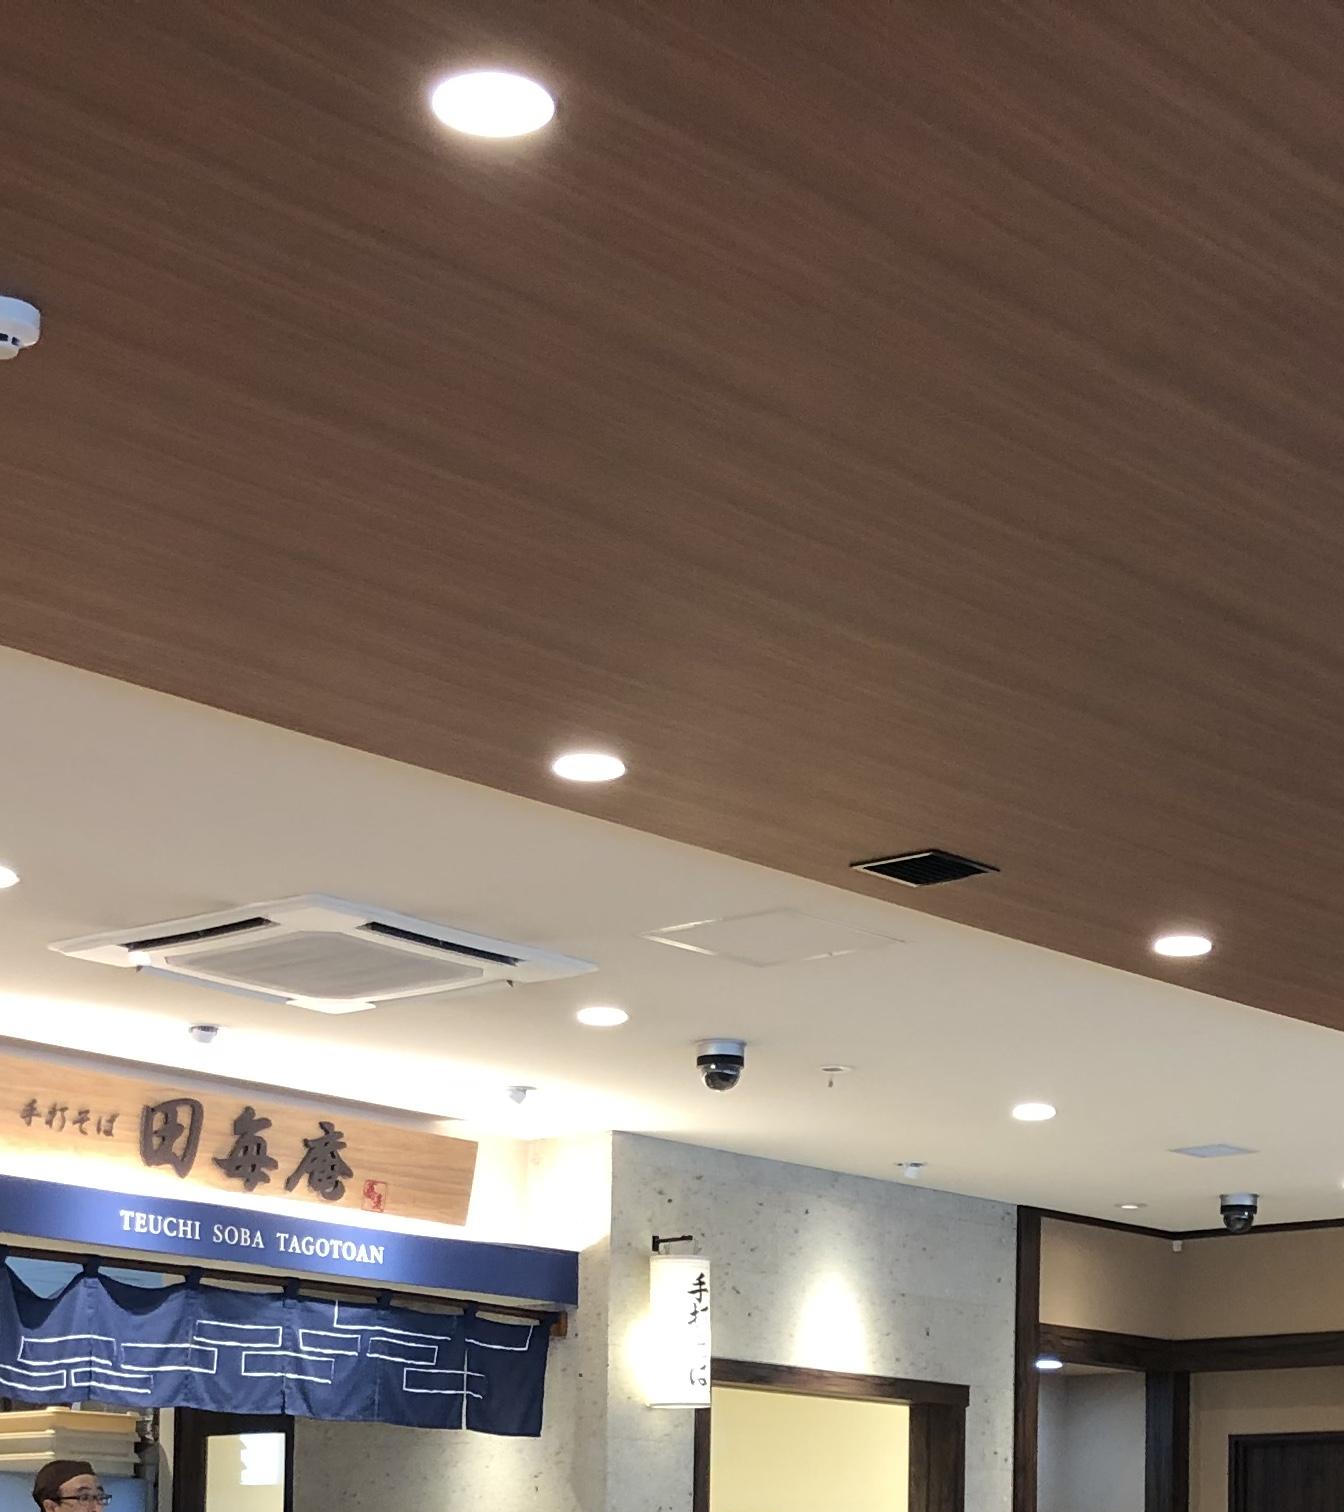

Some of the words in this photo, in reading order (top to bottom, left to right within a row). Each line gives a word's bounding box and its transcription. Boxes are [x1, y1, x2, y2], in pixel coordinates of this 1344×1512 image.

[119, 1208, 201, 1241] TEUCHI
[212, 1223, 265, 1249] SOBA
[275, 1231, 385, 1265] TAGOTOAN
